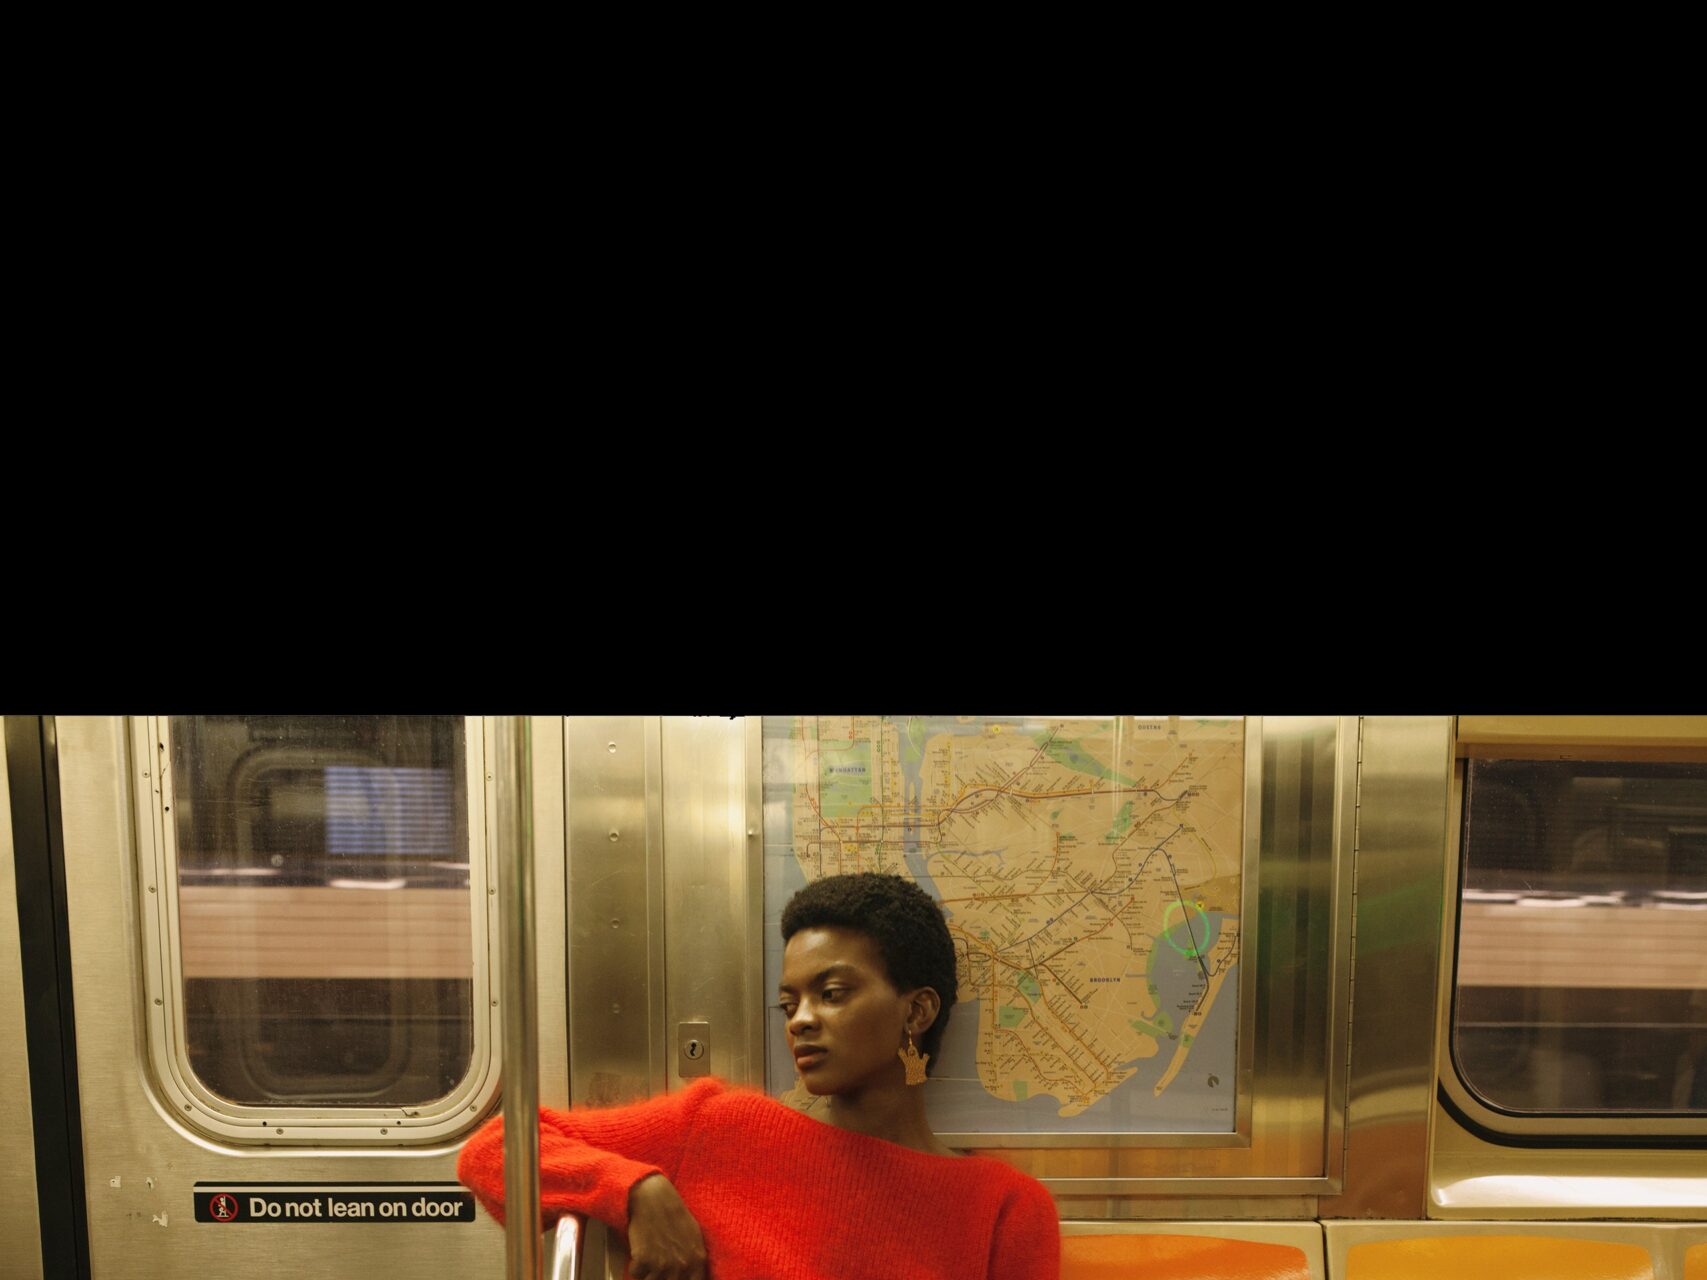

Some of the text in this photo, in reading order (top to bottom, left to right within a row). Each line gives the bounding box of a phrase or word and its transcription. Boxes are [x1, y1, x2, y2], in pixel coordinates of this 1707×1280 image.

[1089, 976, 1121, 984] BROOKLYN
[249, 1197, 464, 1217] Do not lean on door
